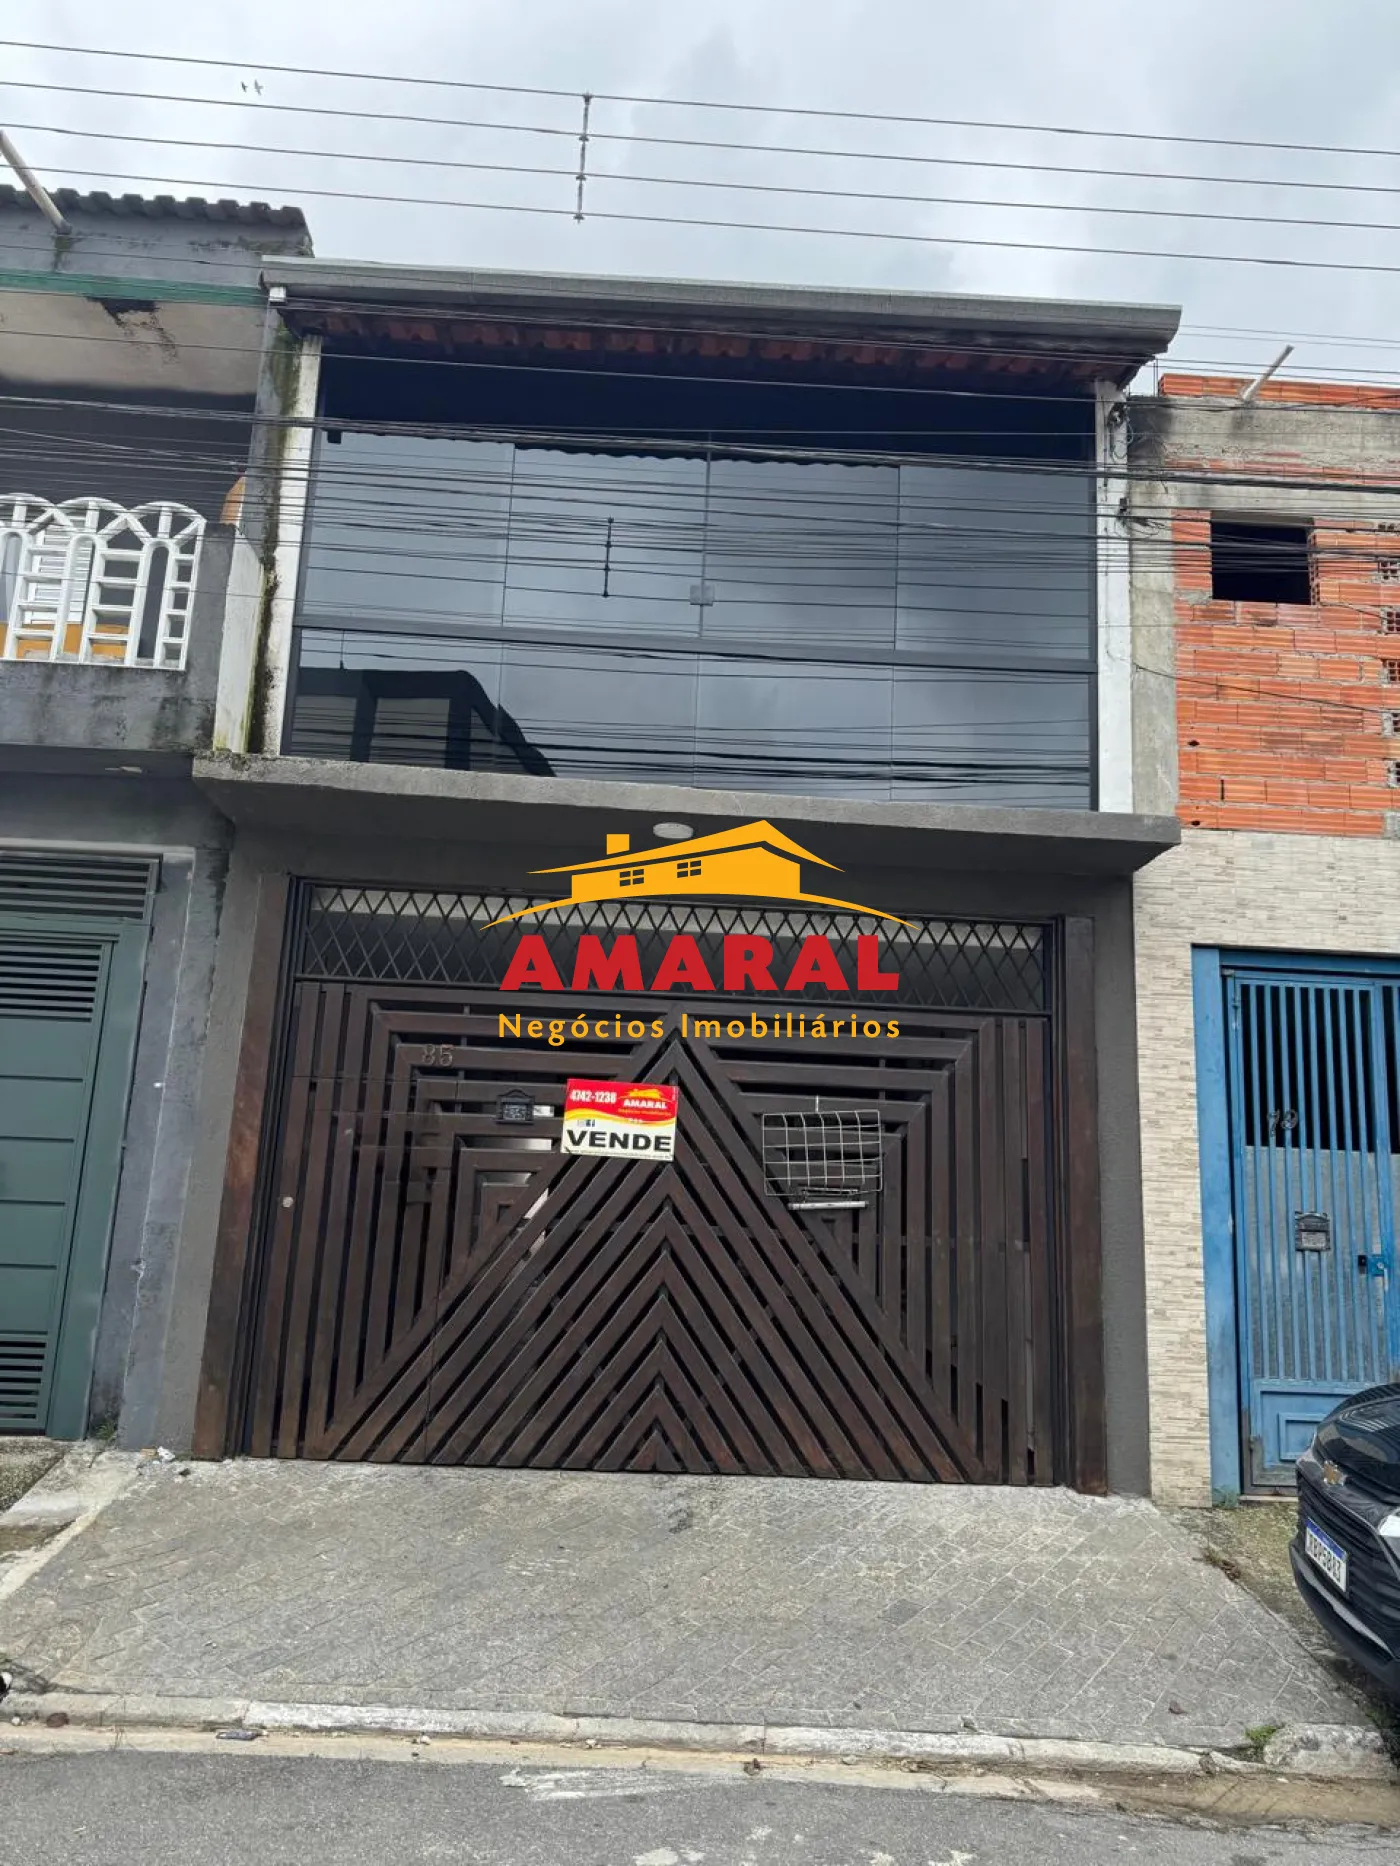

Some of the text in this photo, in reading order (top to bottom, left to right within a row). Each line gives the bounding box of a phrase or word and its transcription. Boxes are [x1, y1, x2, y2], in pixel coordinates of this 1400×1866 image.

[422, 1043, 455, 1066] 85
[623, 1098, 667, 1110] AMARAL
[567, 1129, 672, 1152] VENDE
